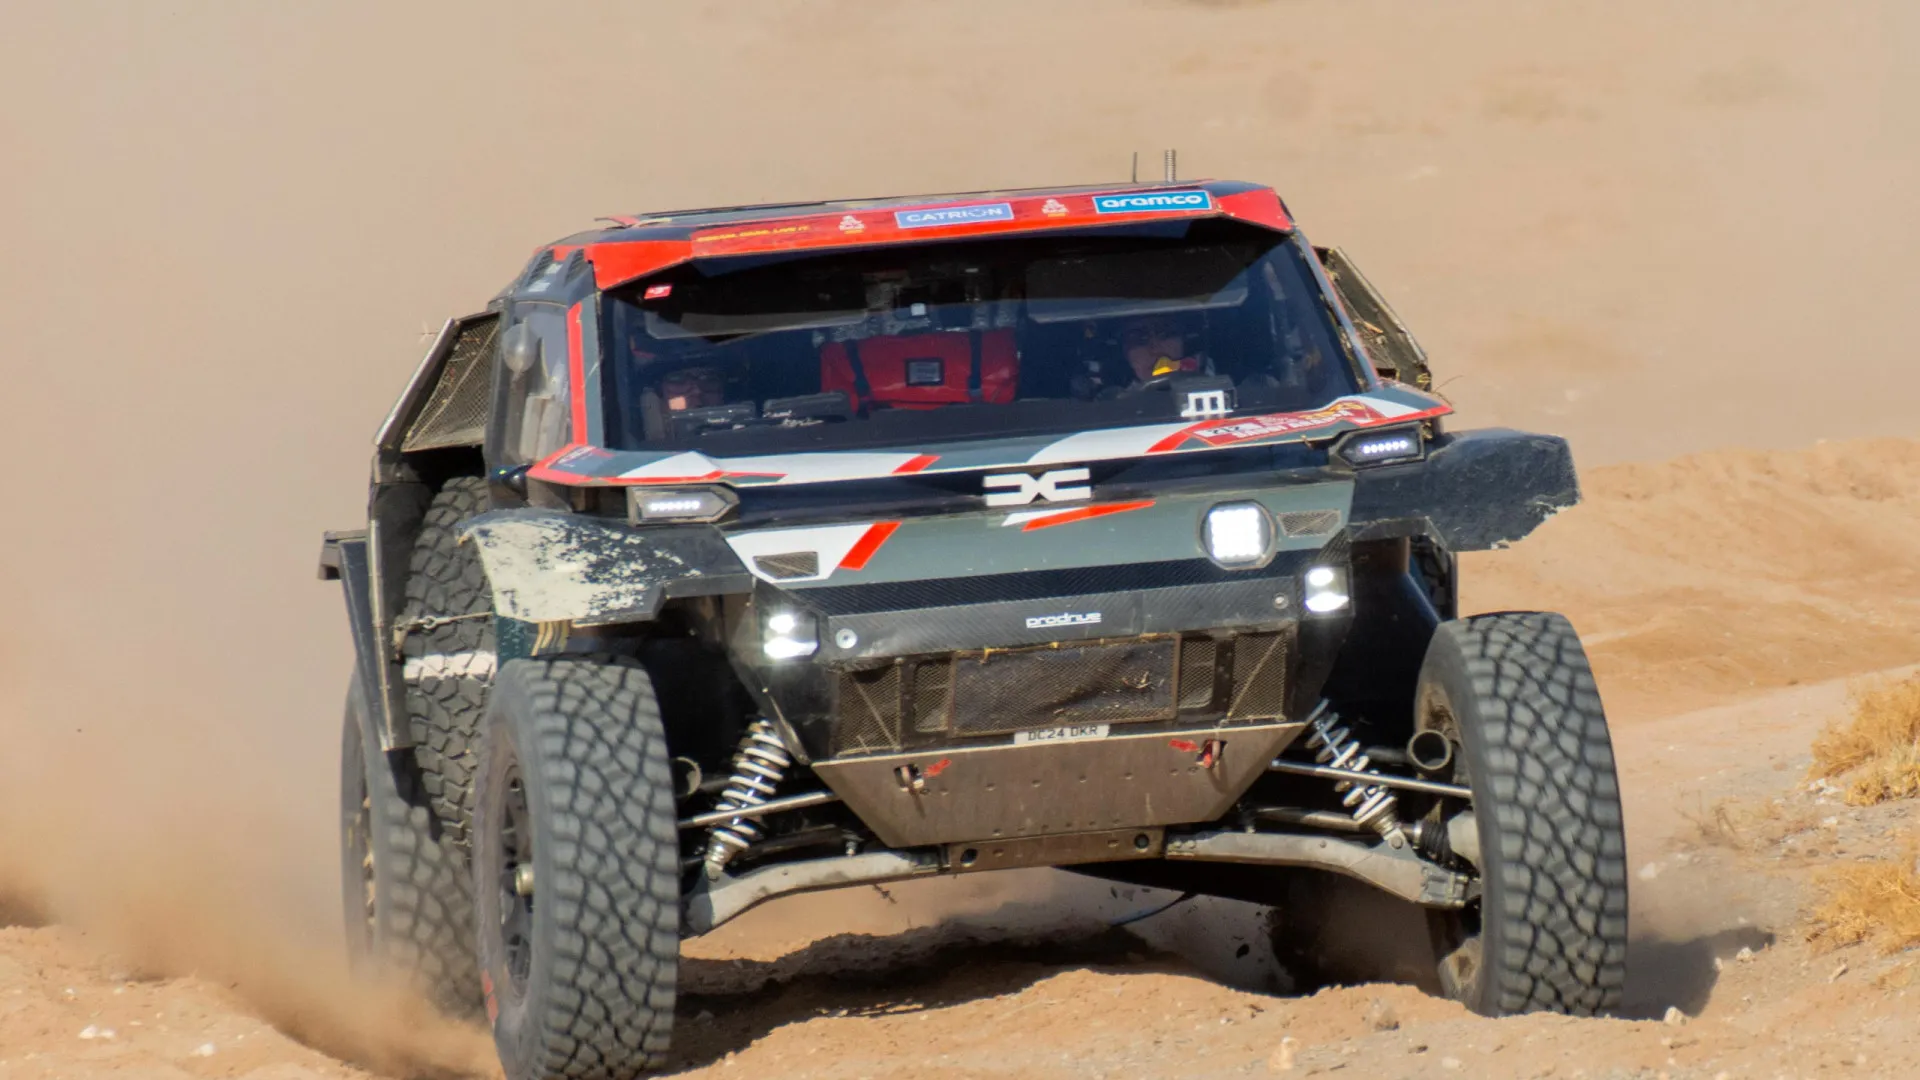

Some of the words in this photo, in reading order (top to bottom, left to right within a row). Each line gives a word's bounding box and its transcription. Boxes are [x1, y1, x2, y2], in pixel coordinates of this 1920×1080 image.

[1101, 194, 1203, 209] aramco
[906, 207, 1003, 223] CATRION
[1028, 728, 1065, 741] DC24
[1070, 724, 1098, 737] DKR
